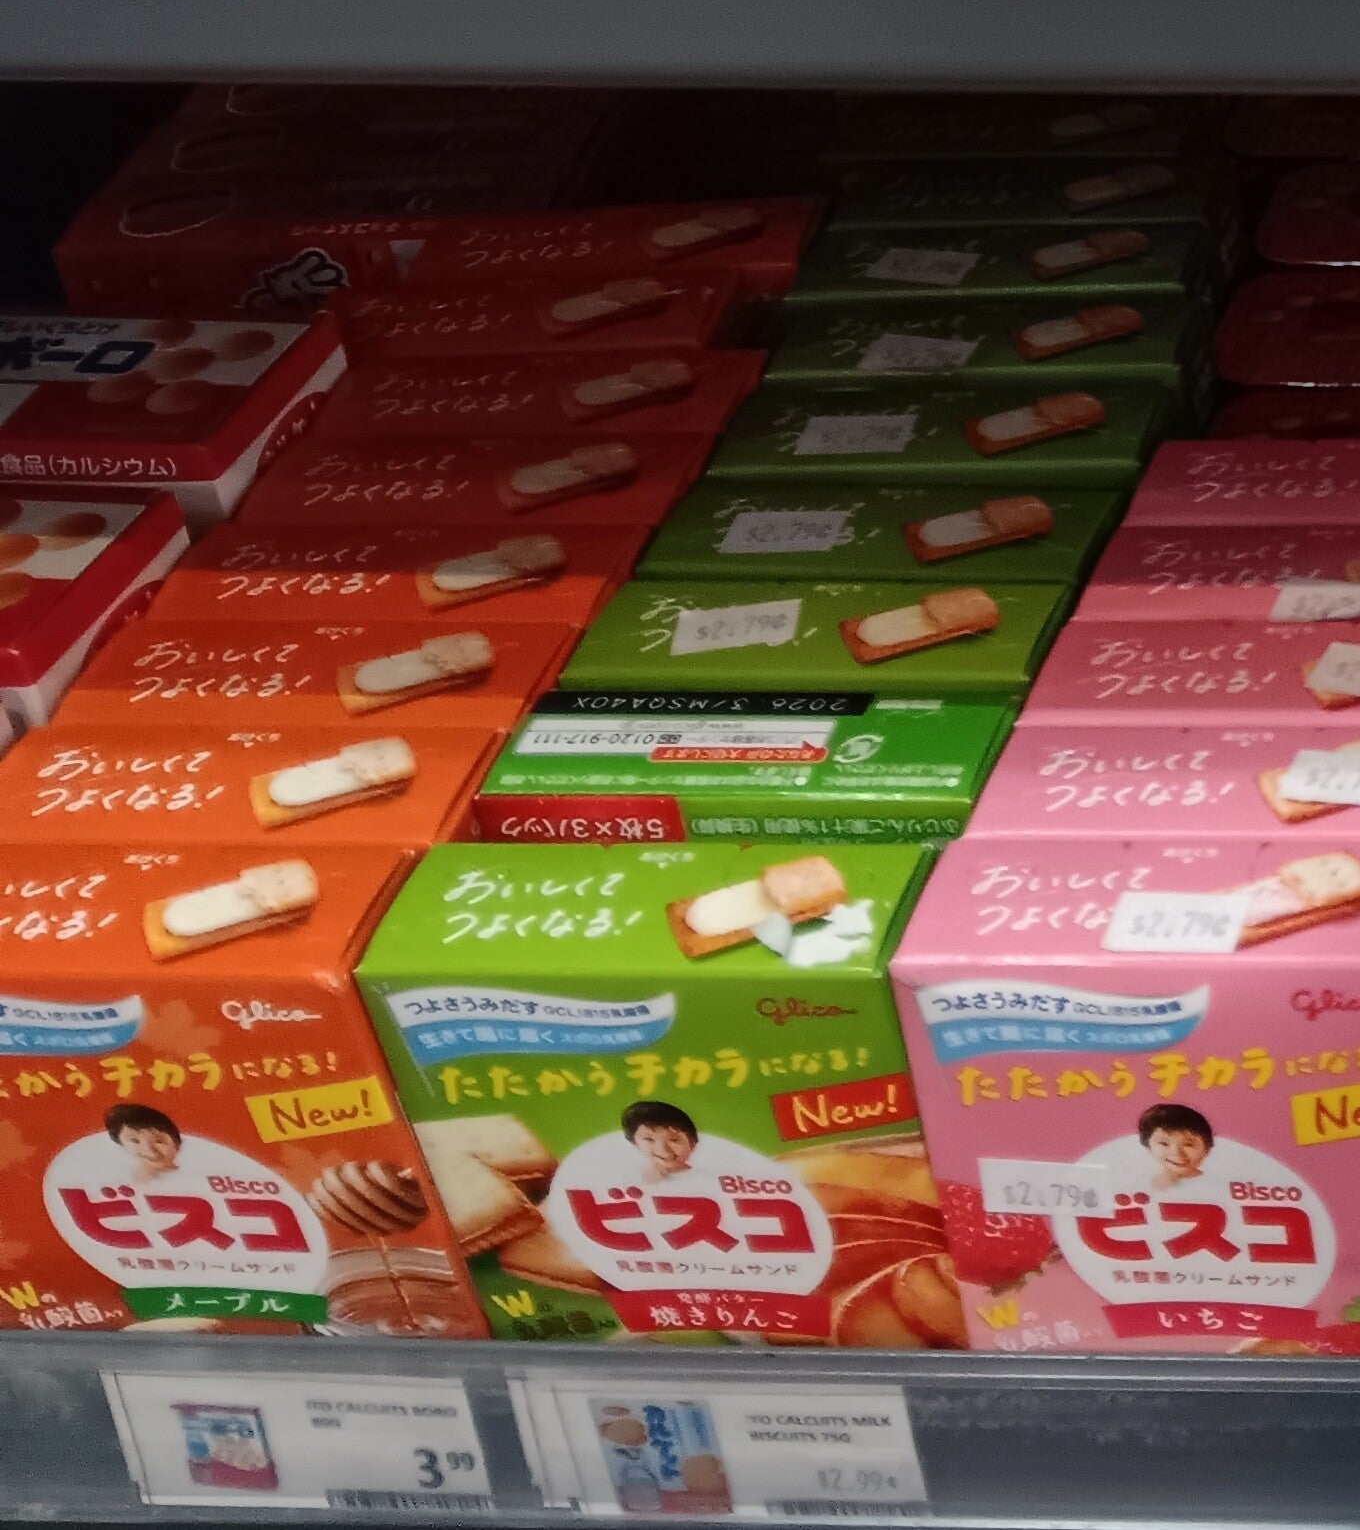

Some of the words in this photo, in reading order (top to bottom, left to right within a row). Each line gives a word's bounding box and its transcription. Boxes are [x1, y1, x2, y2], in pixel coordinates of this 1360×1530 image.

[1040, 748, 1214, 780] おいしくて
[442, 869, 630, 907] おいしくて
[220, 1000, 324, 1031] Glico
[755, 996, 860, 1027] Glico
[268, 1089, 371, 1135] New!
[791, 1084, 901, 1135] New!
[208, 1174, 281, 1197] Bisco
[718, 1174, 793, 1196] Bisco
[1228, 1181, 1303, 1204] Bisco
[57, 1184, 312, 1255] ビスコ
[565, 1184, 817, 1255] ビスコ
[1075, 1190, 1318, 1265] ビスコ
[649, 1303, 802, 1330] 焼きりんご
[1156, 1307, 1266, 1330] いちご
[411, 1446, 445, 1491] 3
